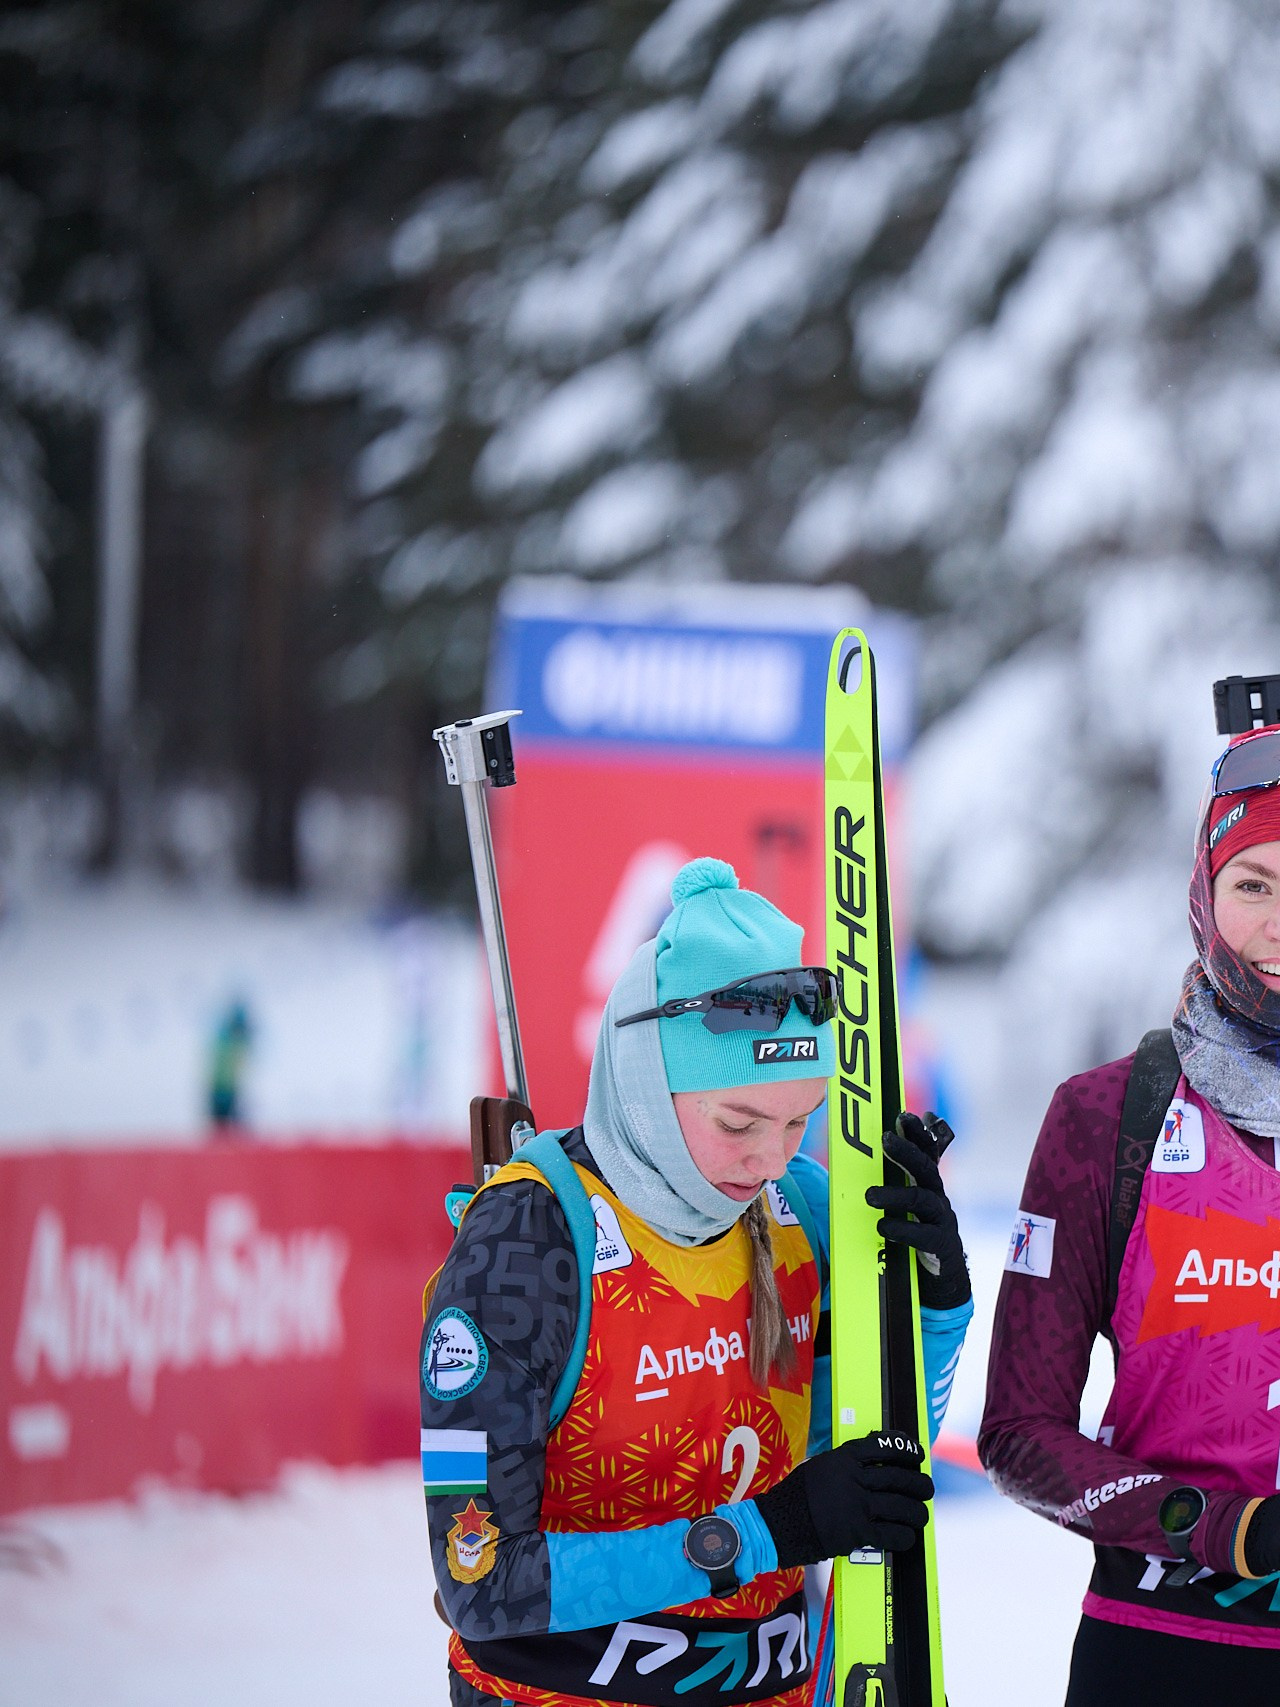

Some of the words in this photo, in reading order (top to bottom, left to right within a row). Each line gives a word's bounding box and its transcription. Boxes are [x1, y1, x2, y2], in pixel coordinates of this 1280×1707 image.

[1209, 802, 1245, 849] PARI
[834, 806, 873, 1159] FISCHER
[758, 1040, 815, 1060] PARI
[1162, 1153, 1190, 1162] СБР
[596, 1248, 620, 1262] СБР
[634, 1327, 746, 1385] Альфа
[721, 1425, 760, 1505] 2
[878, 1436, 919, 1456] MOAX
[886, 1595, 893, 1605] 3D
[886, 1605, 894, 1645] speedmax
[588, 1611, 808, 1695] PARI
